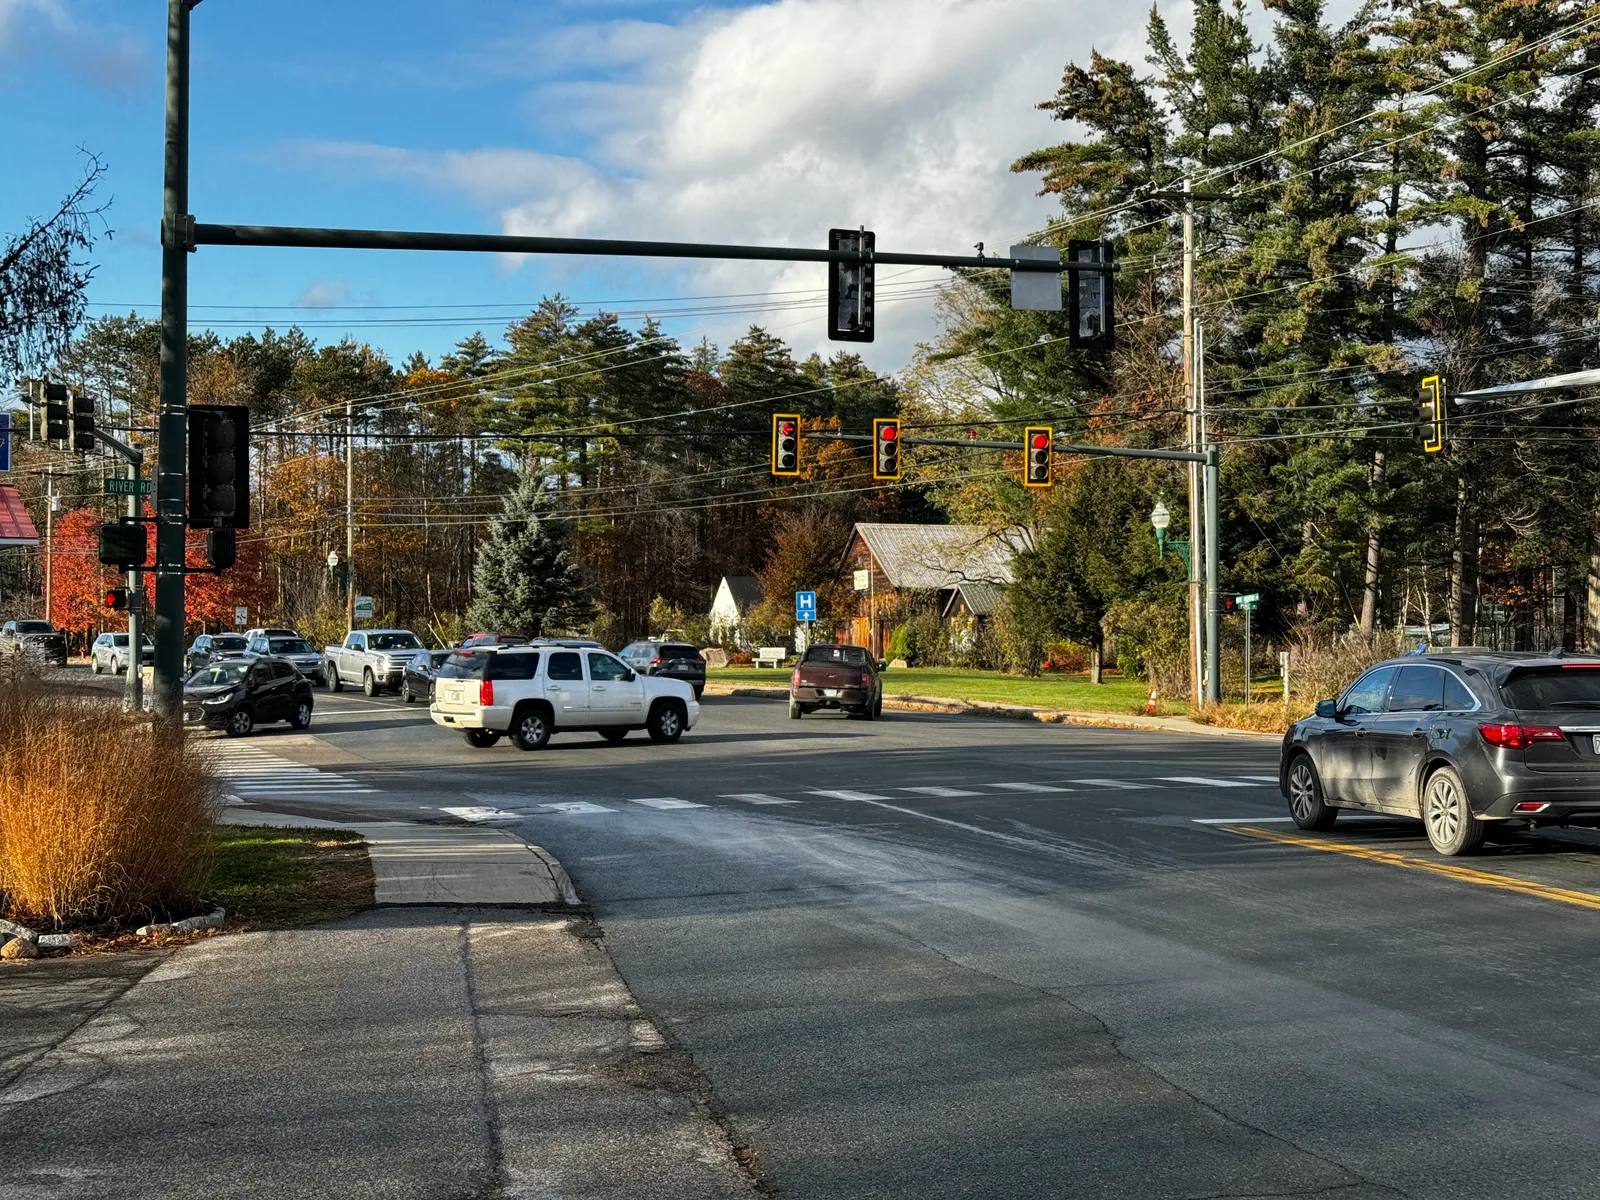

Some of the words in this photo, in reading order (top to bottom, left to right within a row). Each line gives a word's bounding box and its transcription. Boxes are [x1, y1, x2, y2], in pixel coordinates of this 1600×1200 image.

[109, 480, 135, 493] RIVER
[140, 482, 152, 493] RD
[800, 594, 812, 609] H
